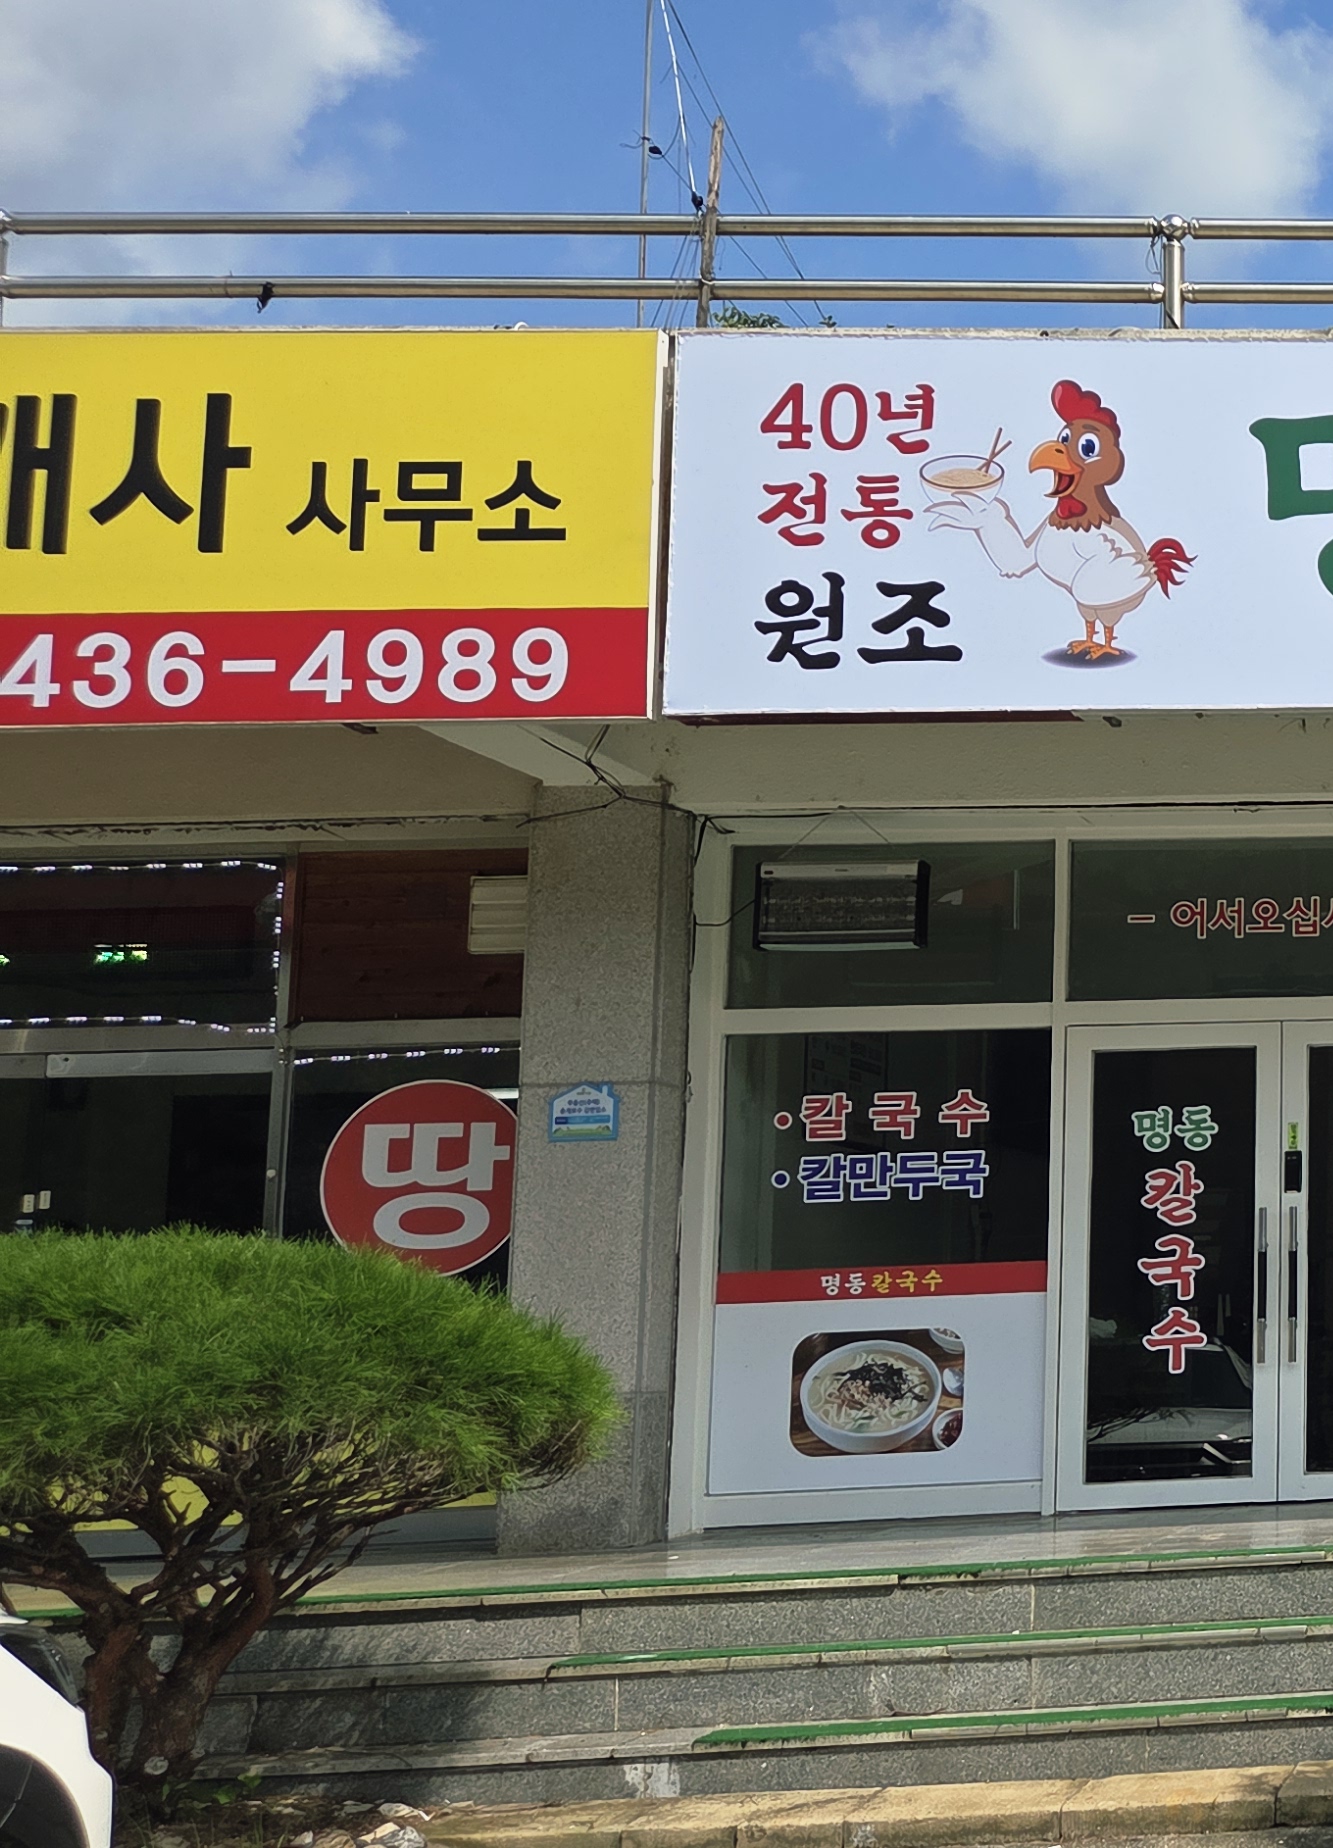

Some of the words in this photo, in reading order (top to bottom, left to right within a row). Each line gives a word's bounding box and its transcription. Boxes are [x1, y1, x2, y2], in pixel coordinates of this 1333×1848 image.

[760, 382, 935, 455] 40년
[286, 458, 567, 552] 사무소
[758, 472, 913, 548] 전통
[754, 571, 963, 670] 원조
[0, 626, 569, 708] 436-4989
[1131, 1105, 1218, 1153] 명동
[360, 1121, 511, 1250] 땅
[797, 1150, 990, 1204] 칼만두국
